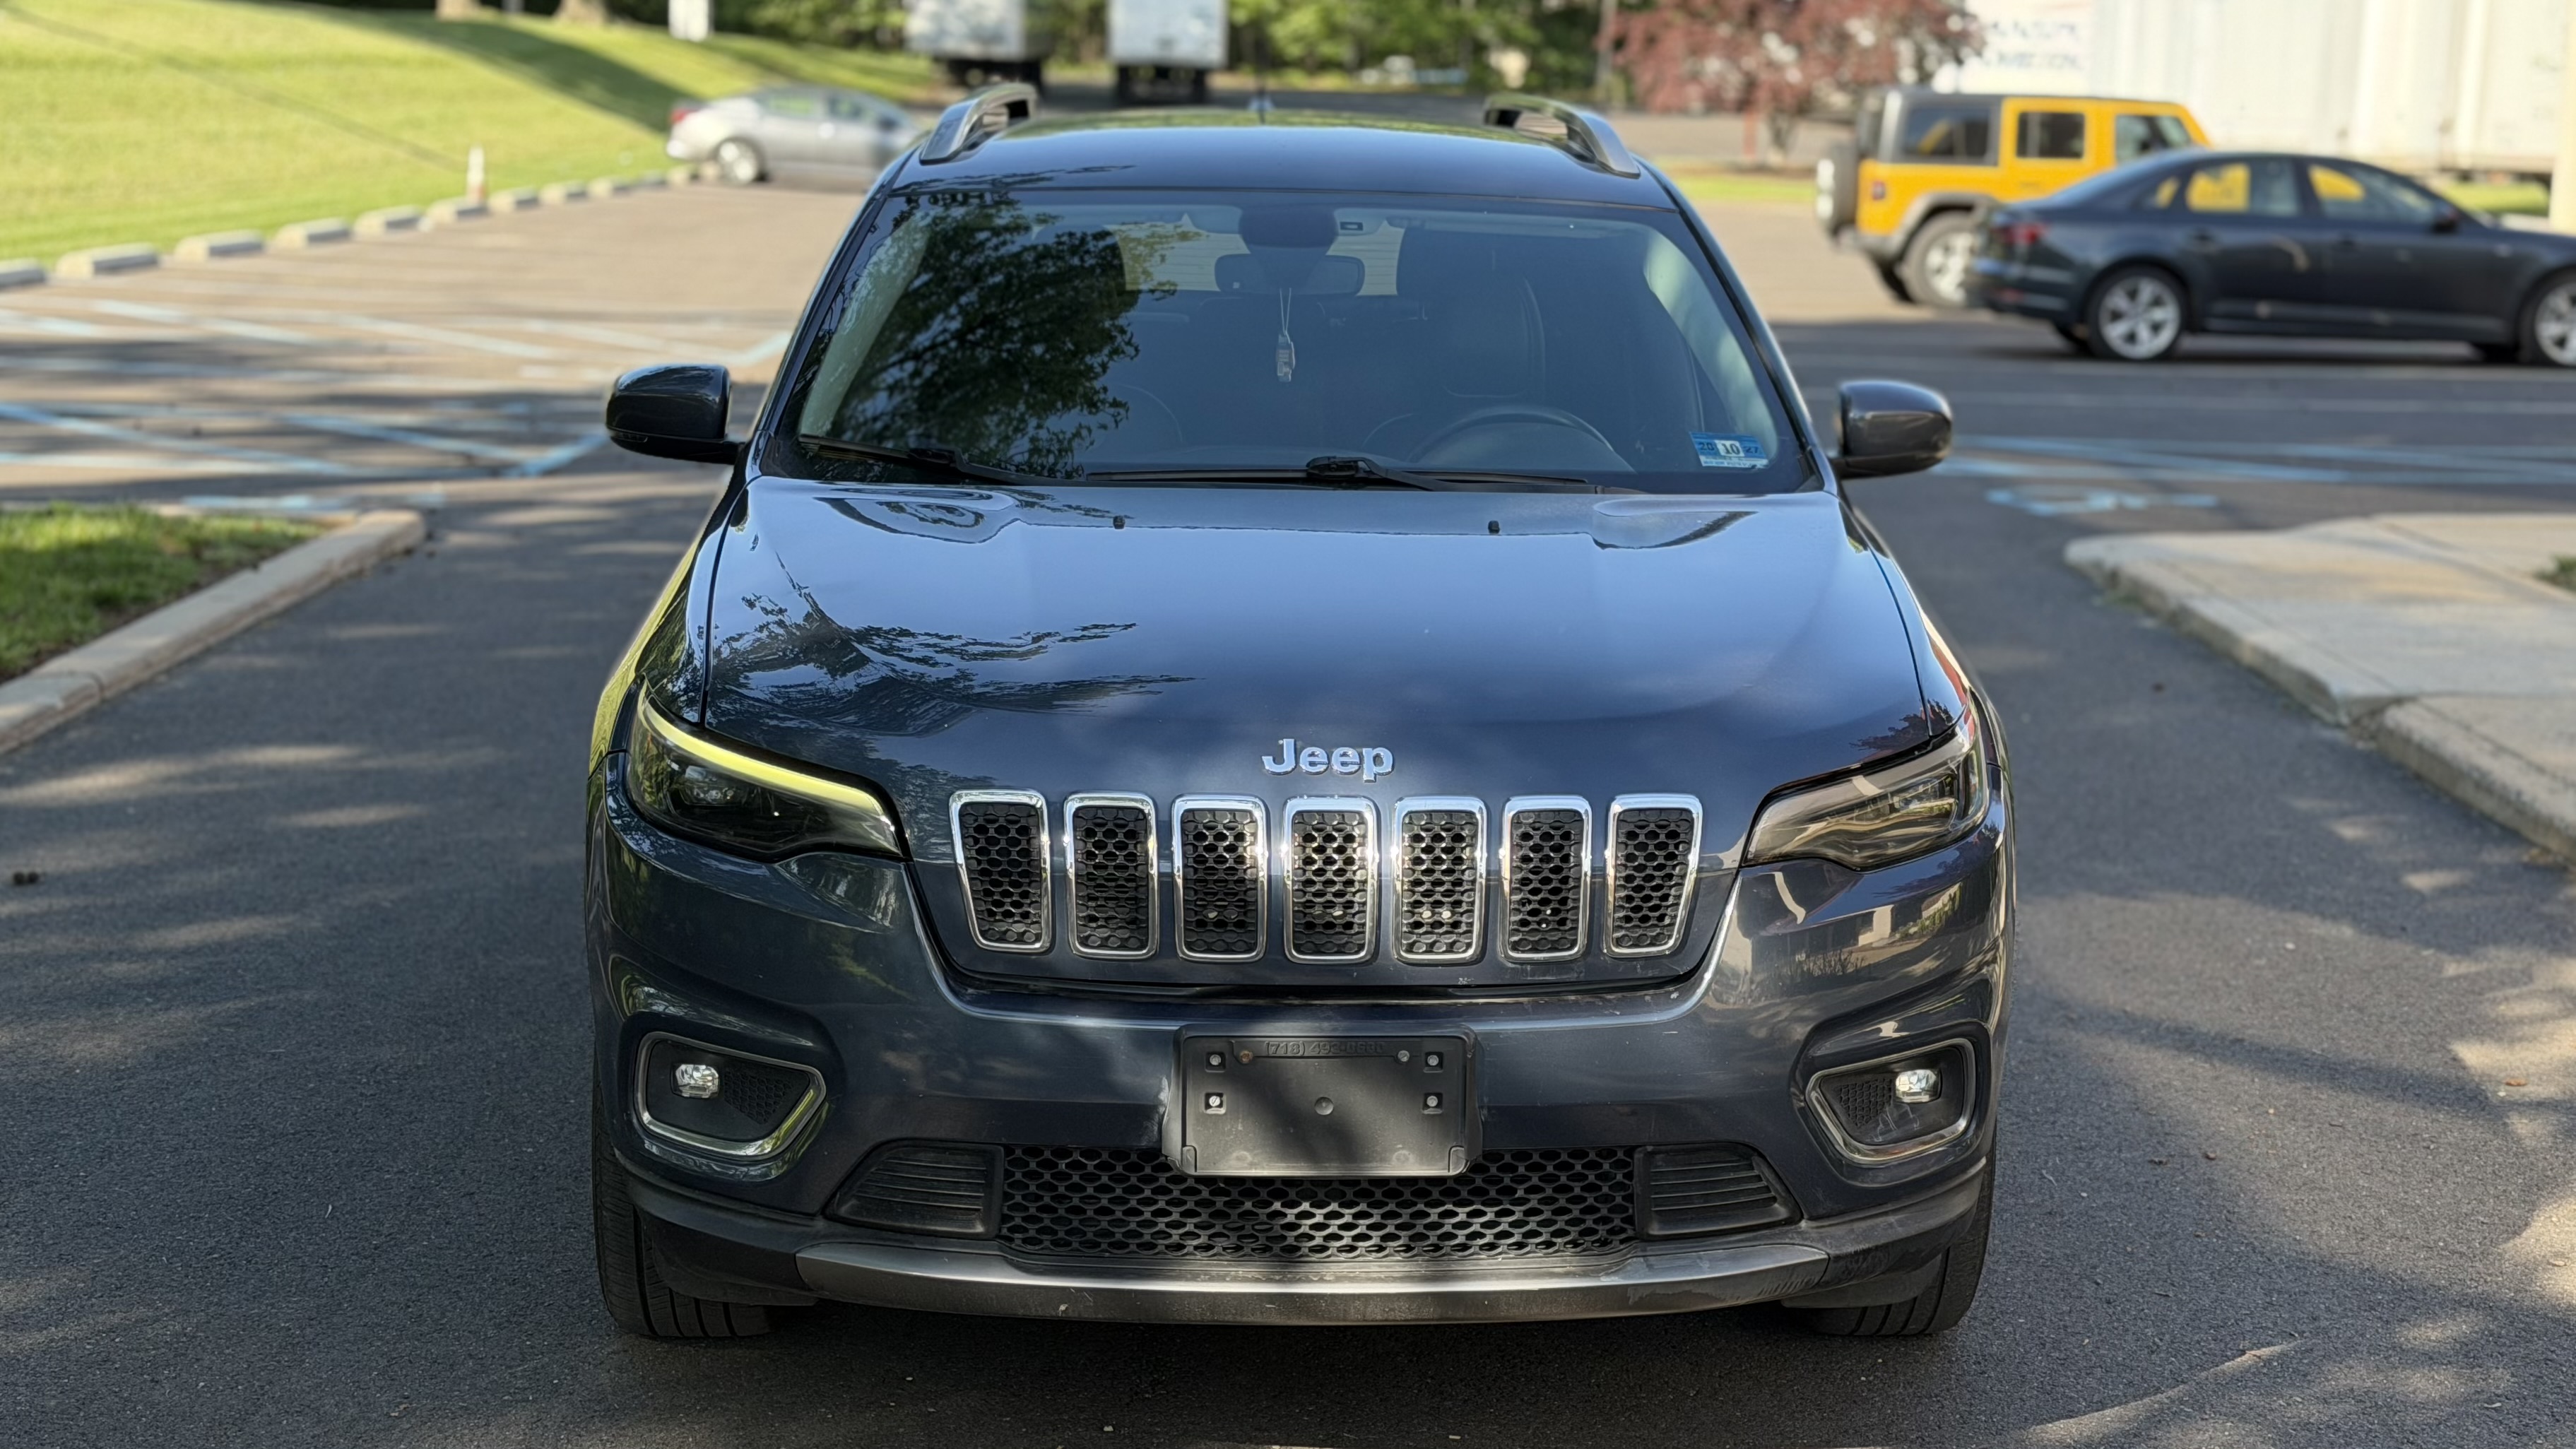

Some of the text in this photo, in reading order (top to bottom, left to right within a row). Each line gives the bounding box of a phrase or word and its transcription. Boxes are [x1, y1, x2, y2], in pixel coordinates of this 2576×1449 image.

[1698, 442, 1715, 451] 20
[1721, 443, 1740, 455] 10
[1262, 738, 1394, 783] Jeep
[1265, 1041, 1306, 1055] (718)
